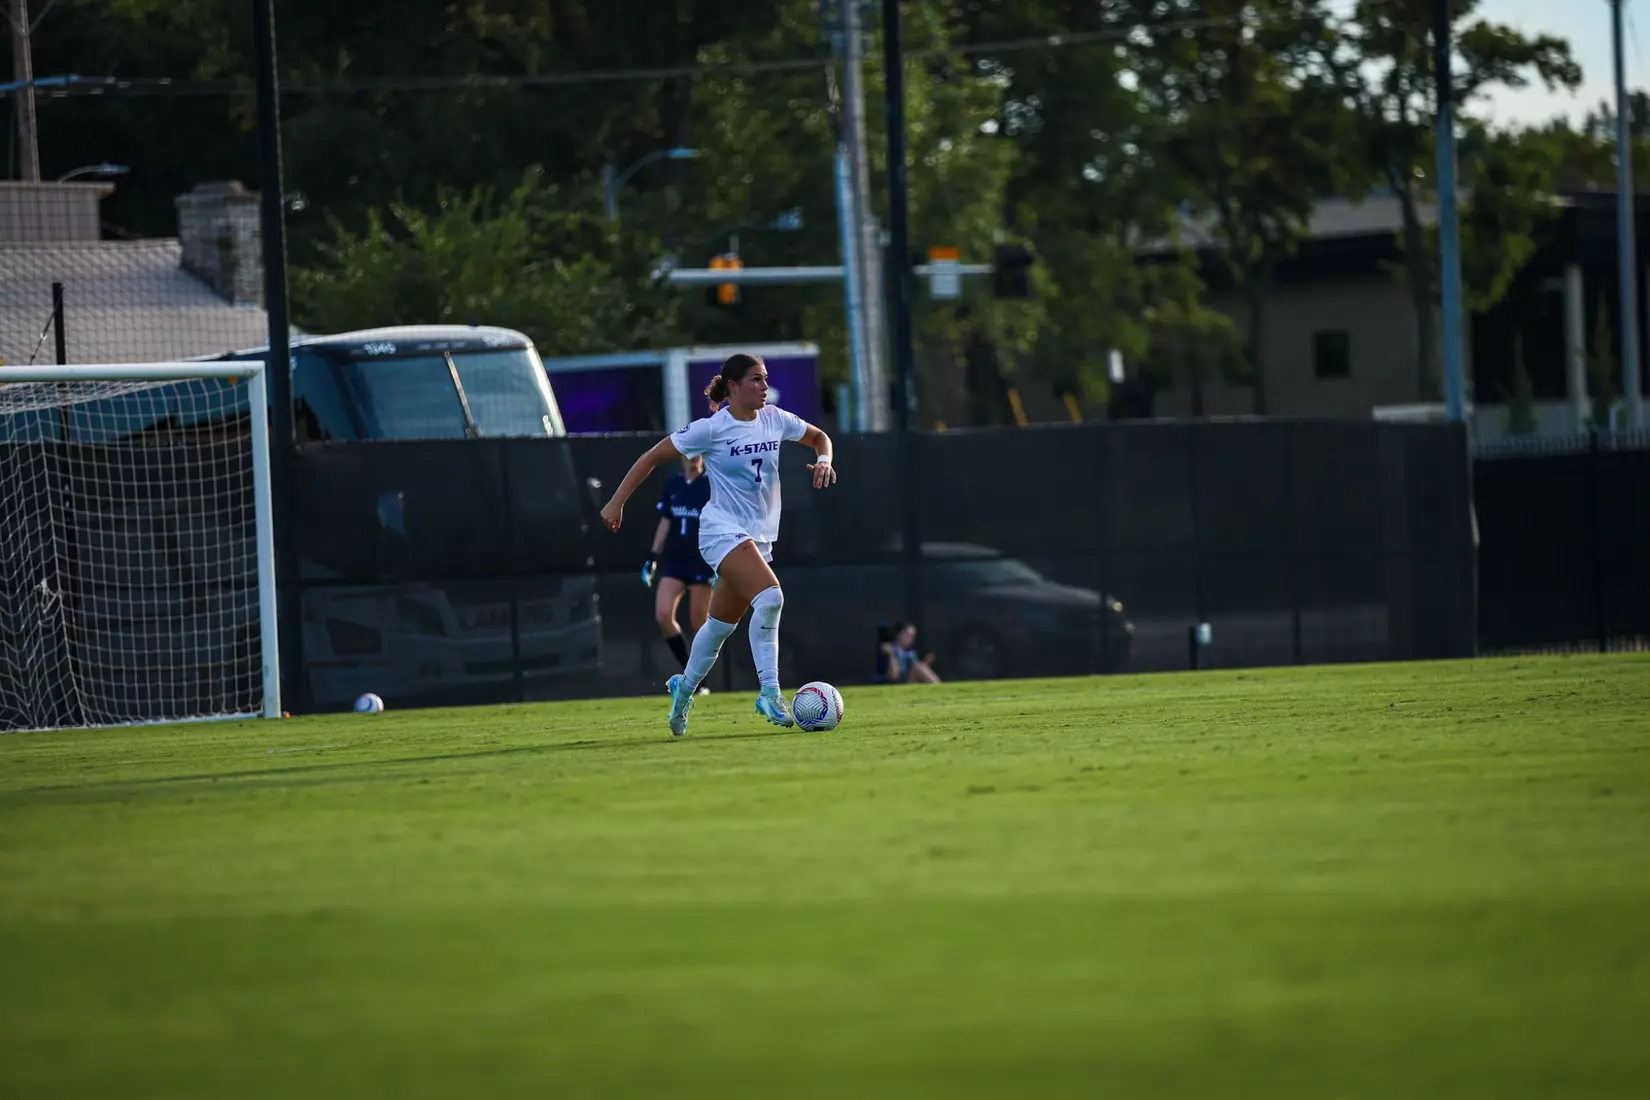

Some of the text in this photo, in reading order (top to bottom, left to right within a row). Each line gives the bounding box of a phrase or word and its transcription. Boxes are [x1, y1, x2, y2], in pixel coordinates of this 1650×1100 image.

[730, 440, 778, 457] K-STATE
[751, 458, 763, 482] 7
[680, 517, 687, 536] 1
